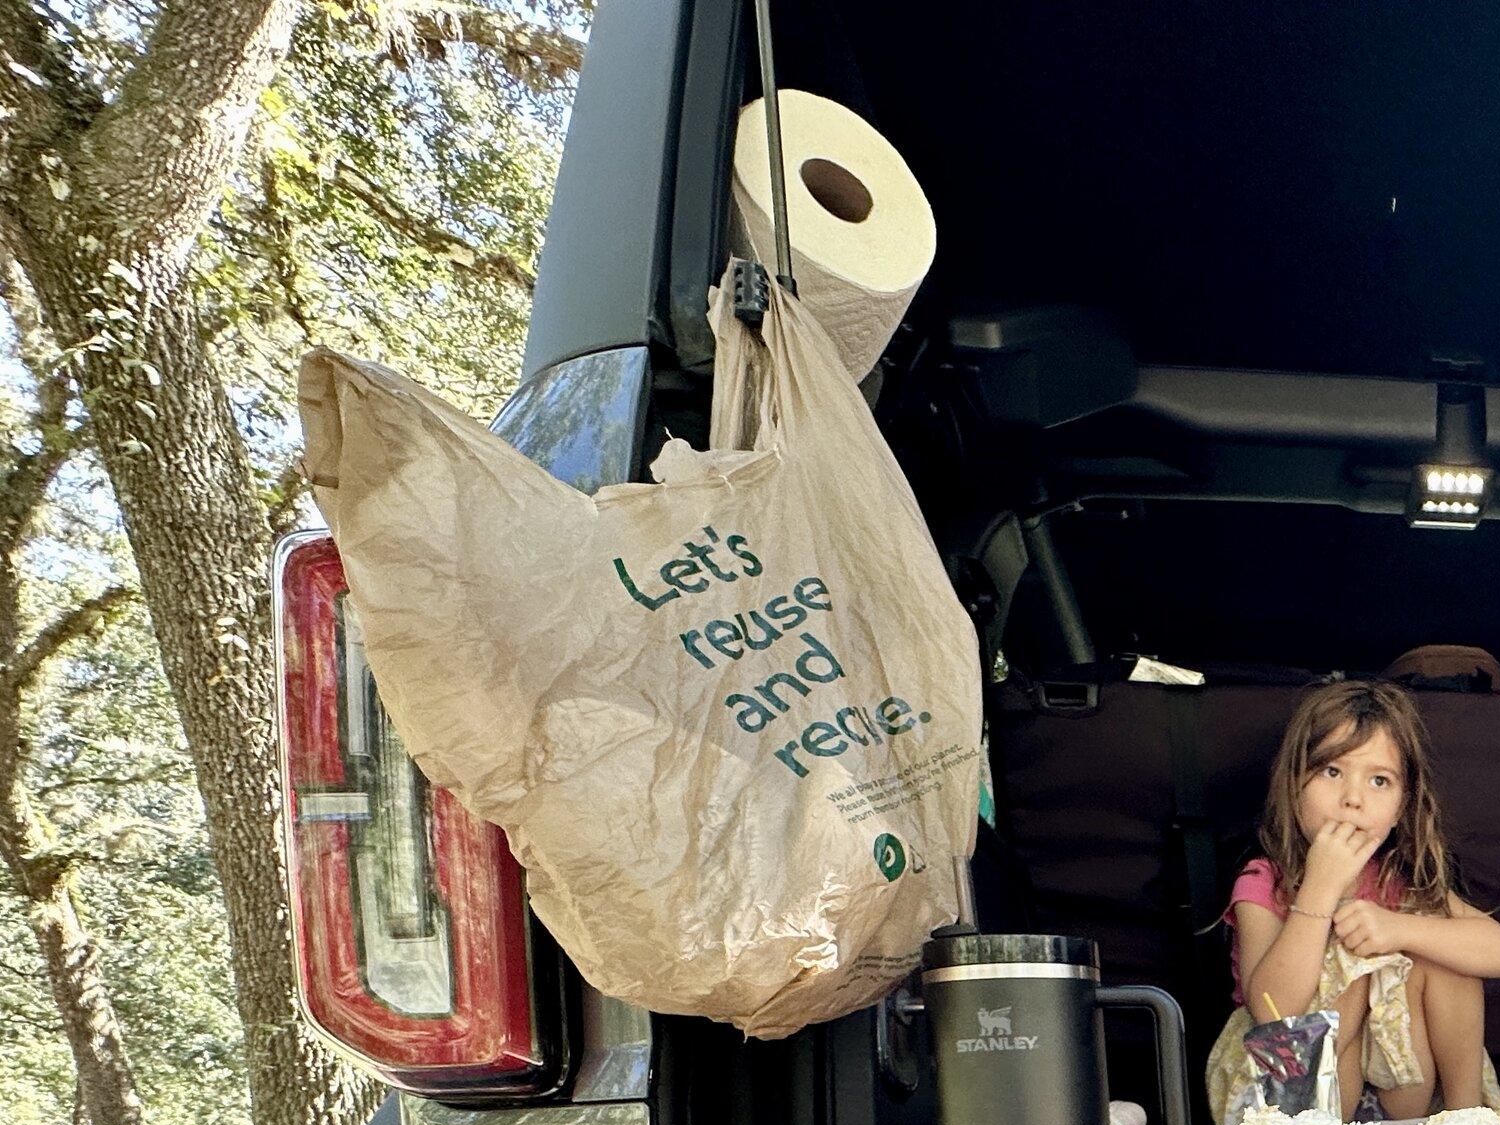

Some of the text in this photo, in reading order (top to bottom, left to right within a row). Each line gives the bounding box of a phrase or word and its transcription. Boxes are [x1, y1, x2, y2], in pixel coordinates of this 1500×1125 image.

[613, 525, 763, 612] Let's
[680, 577, 833, 669] reuse
[725, 632, 846, 733] and
[956, 1035, 1039, 1053] STANLEY
